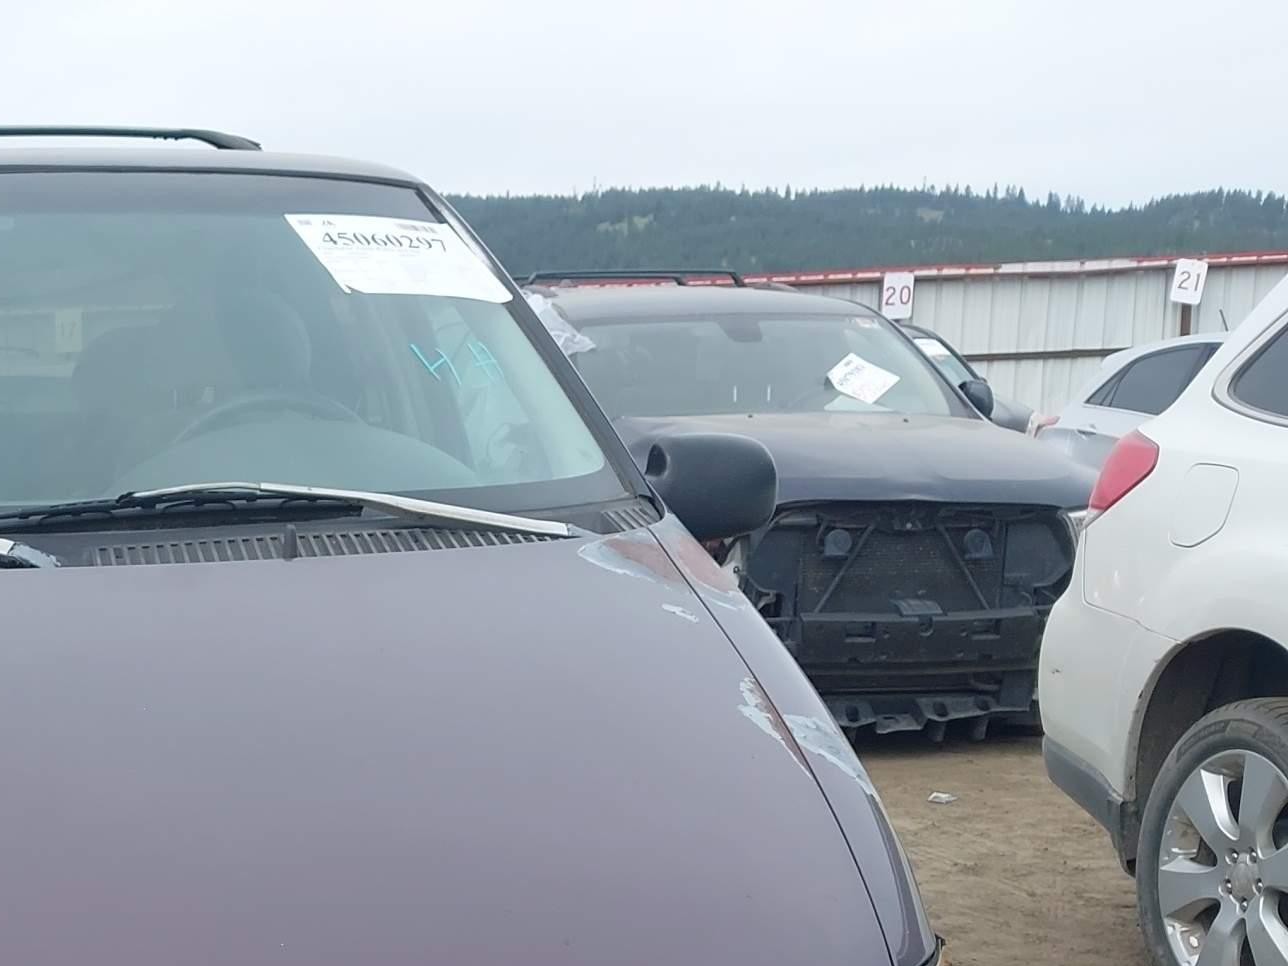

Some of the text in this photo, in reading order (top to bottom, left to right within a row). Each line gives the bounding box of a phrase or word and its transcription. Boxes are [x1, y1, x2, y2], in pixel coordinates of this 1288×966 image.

[322, 232, 447, 252] 45060297
[1177, 271, 1201, 292] 21
[885, 285, 911, 306] 20
